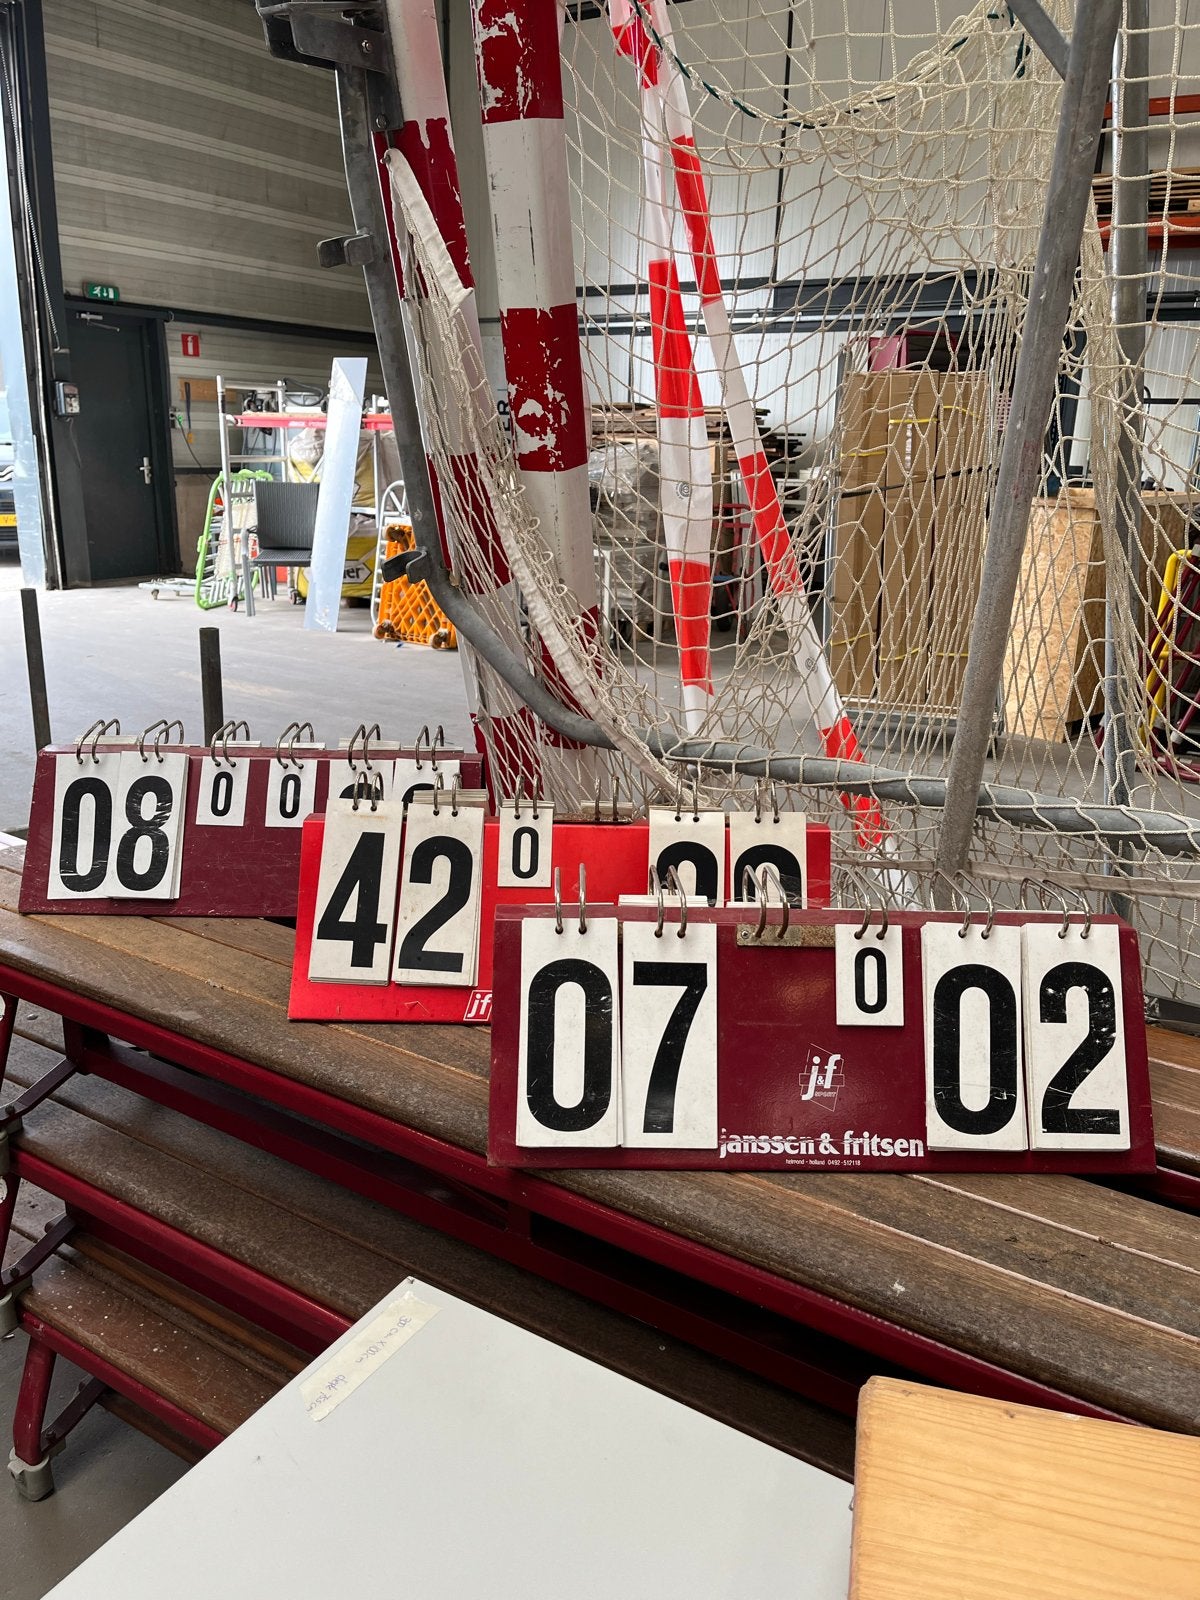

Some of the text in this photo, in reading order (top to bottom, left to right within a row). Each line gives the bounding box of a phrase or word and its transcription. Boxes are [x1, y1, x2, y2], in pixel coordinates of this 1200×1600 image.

[59, 771, 301, 892] 08 0 0
[317, 826, 539, 973] 42 0
[526, 947, 1121, 1136] 07 0 02
[719, 1127, 925, 1159] janssen & fritsen
